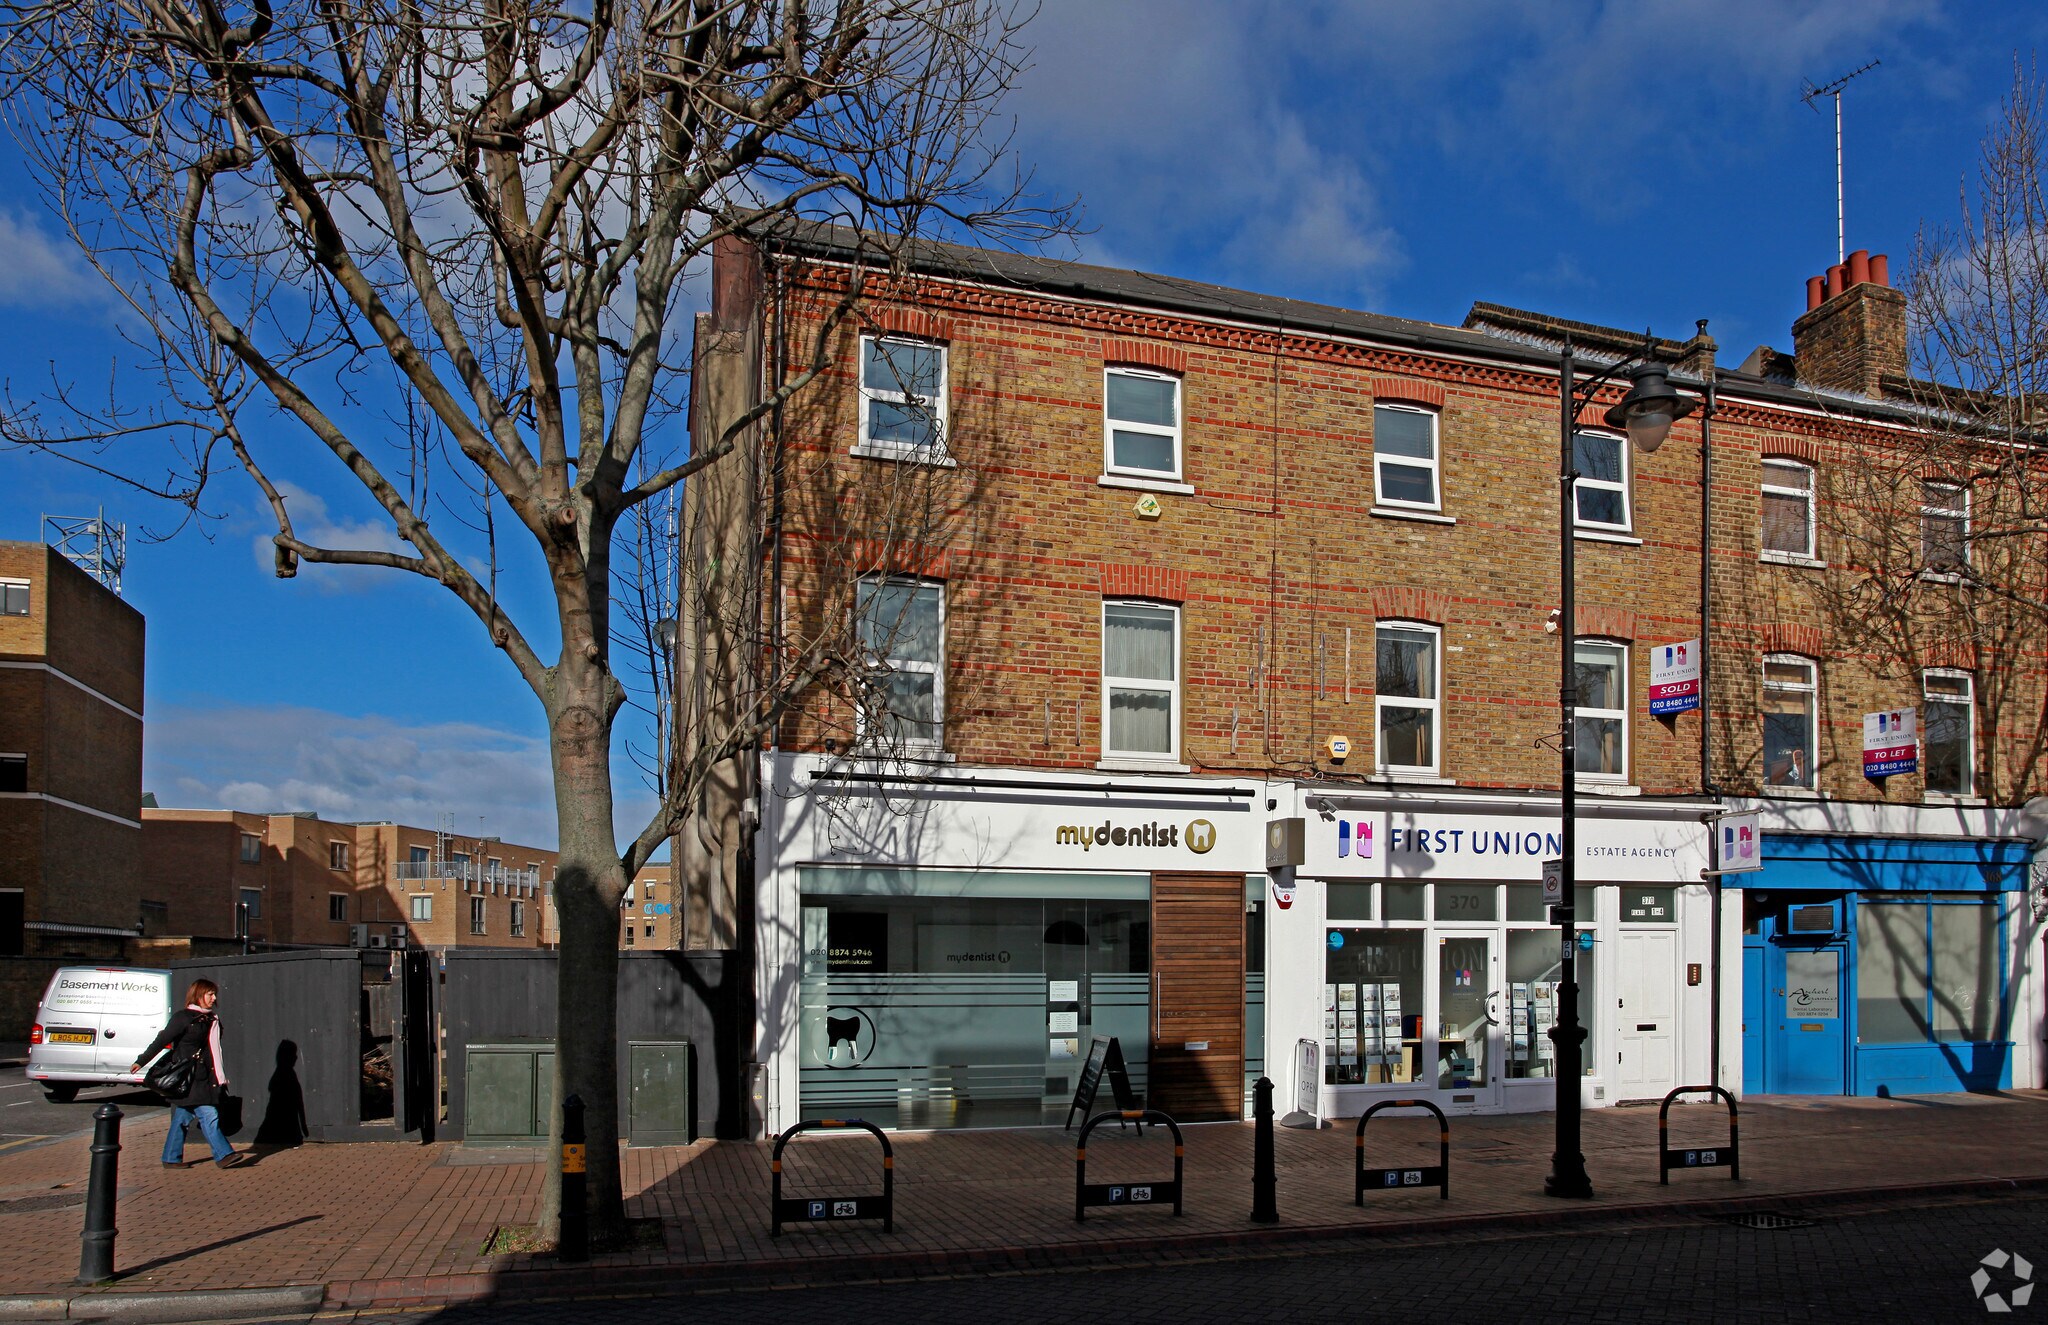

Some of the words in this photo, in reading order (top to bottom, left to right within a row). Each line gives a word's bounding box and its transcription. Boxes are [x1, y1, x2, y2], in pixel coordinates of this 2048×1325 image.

[1656, 671, 1674, 679] FIRST
[1677, 666, 1696, 675] UNION
[1660, 683, 1691, 694] SOLD
[1652, 701, 1664, 709] 020
[1666, 698, 1683, 707] 8480
[1684, 696, 1698, 704] 4444
[1891, 733, 1912, 741] UNION
[1334, 743, 1346, 751] ADT
[1874, 751, 1887, 759] TO
[1890, 749, 1906, 758] LET
[1866, 764, 1878, 772] 020
[1880, 762, 1897, 770] 8480
[1056, 820, 1178, 852] mydentist
[1390, 828, 1464, 854] FIRST
[1471, 831, 1563, 856] UNION
[1586, 846, 1627, 858] ESTATE
[1631, 847, 1677, 859] AGENCY
[1449, 895, 1480, 910] 370
[1642, 896, 1655, 905] 370
[810, 948, 827, 956] 020
[829, 948, 849, 956] 8874
[852, 948, 873, 957] 5946
[947, 952, 995, 964] mydentist
[60, 979, 119, 991] Basement
[121, 982, 159, 993] Works
[1300, 1080, 1318, 1094] OPEN
[1689, 1153, 1695, 1164] P
[1388, 1173, 1396, 1185] P
[1113, 1189, 1122, 1201] P
[812, 1203, 823, 1216] P
